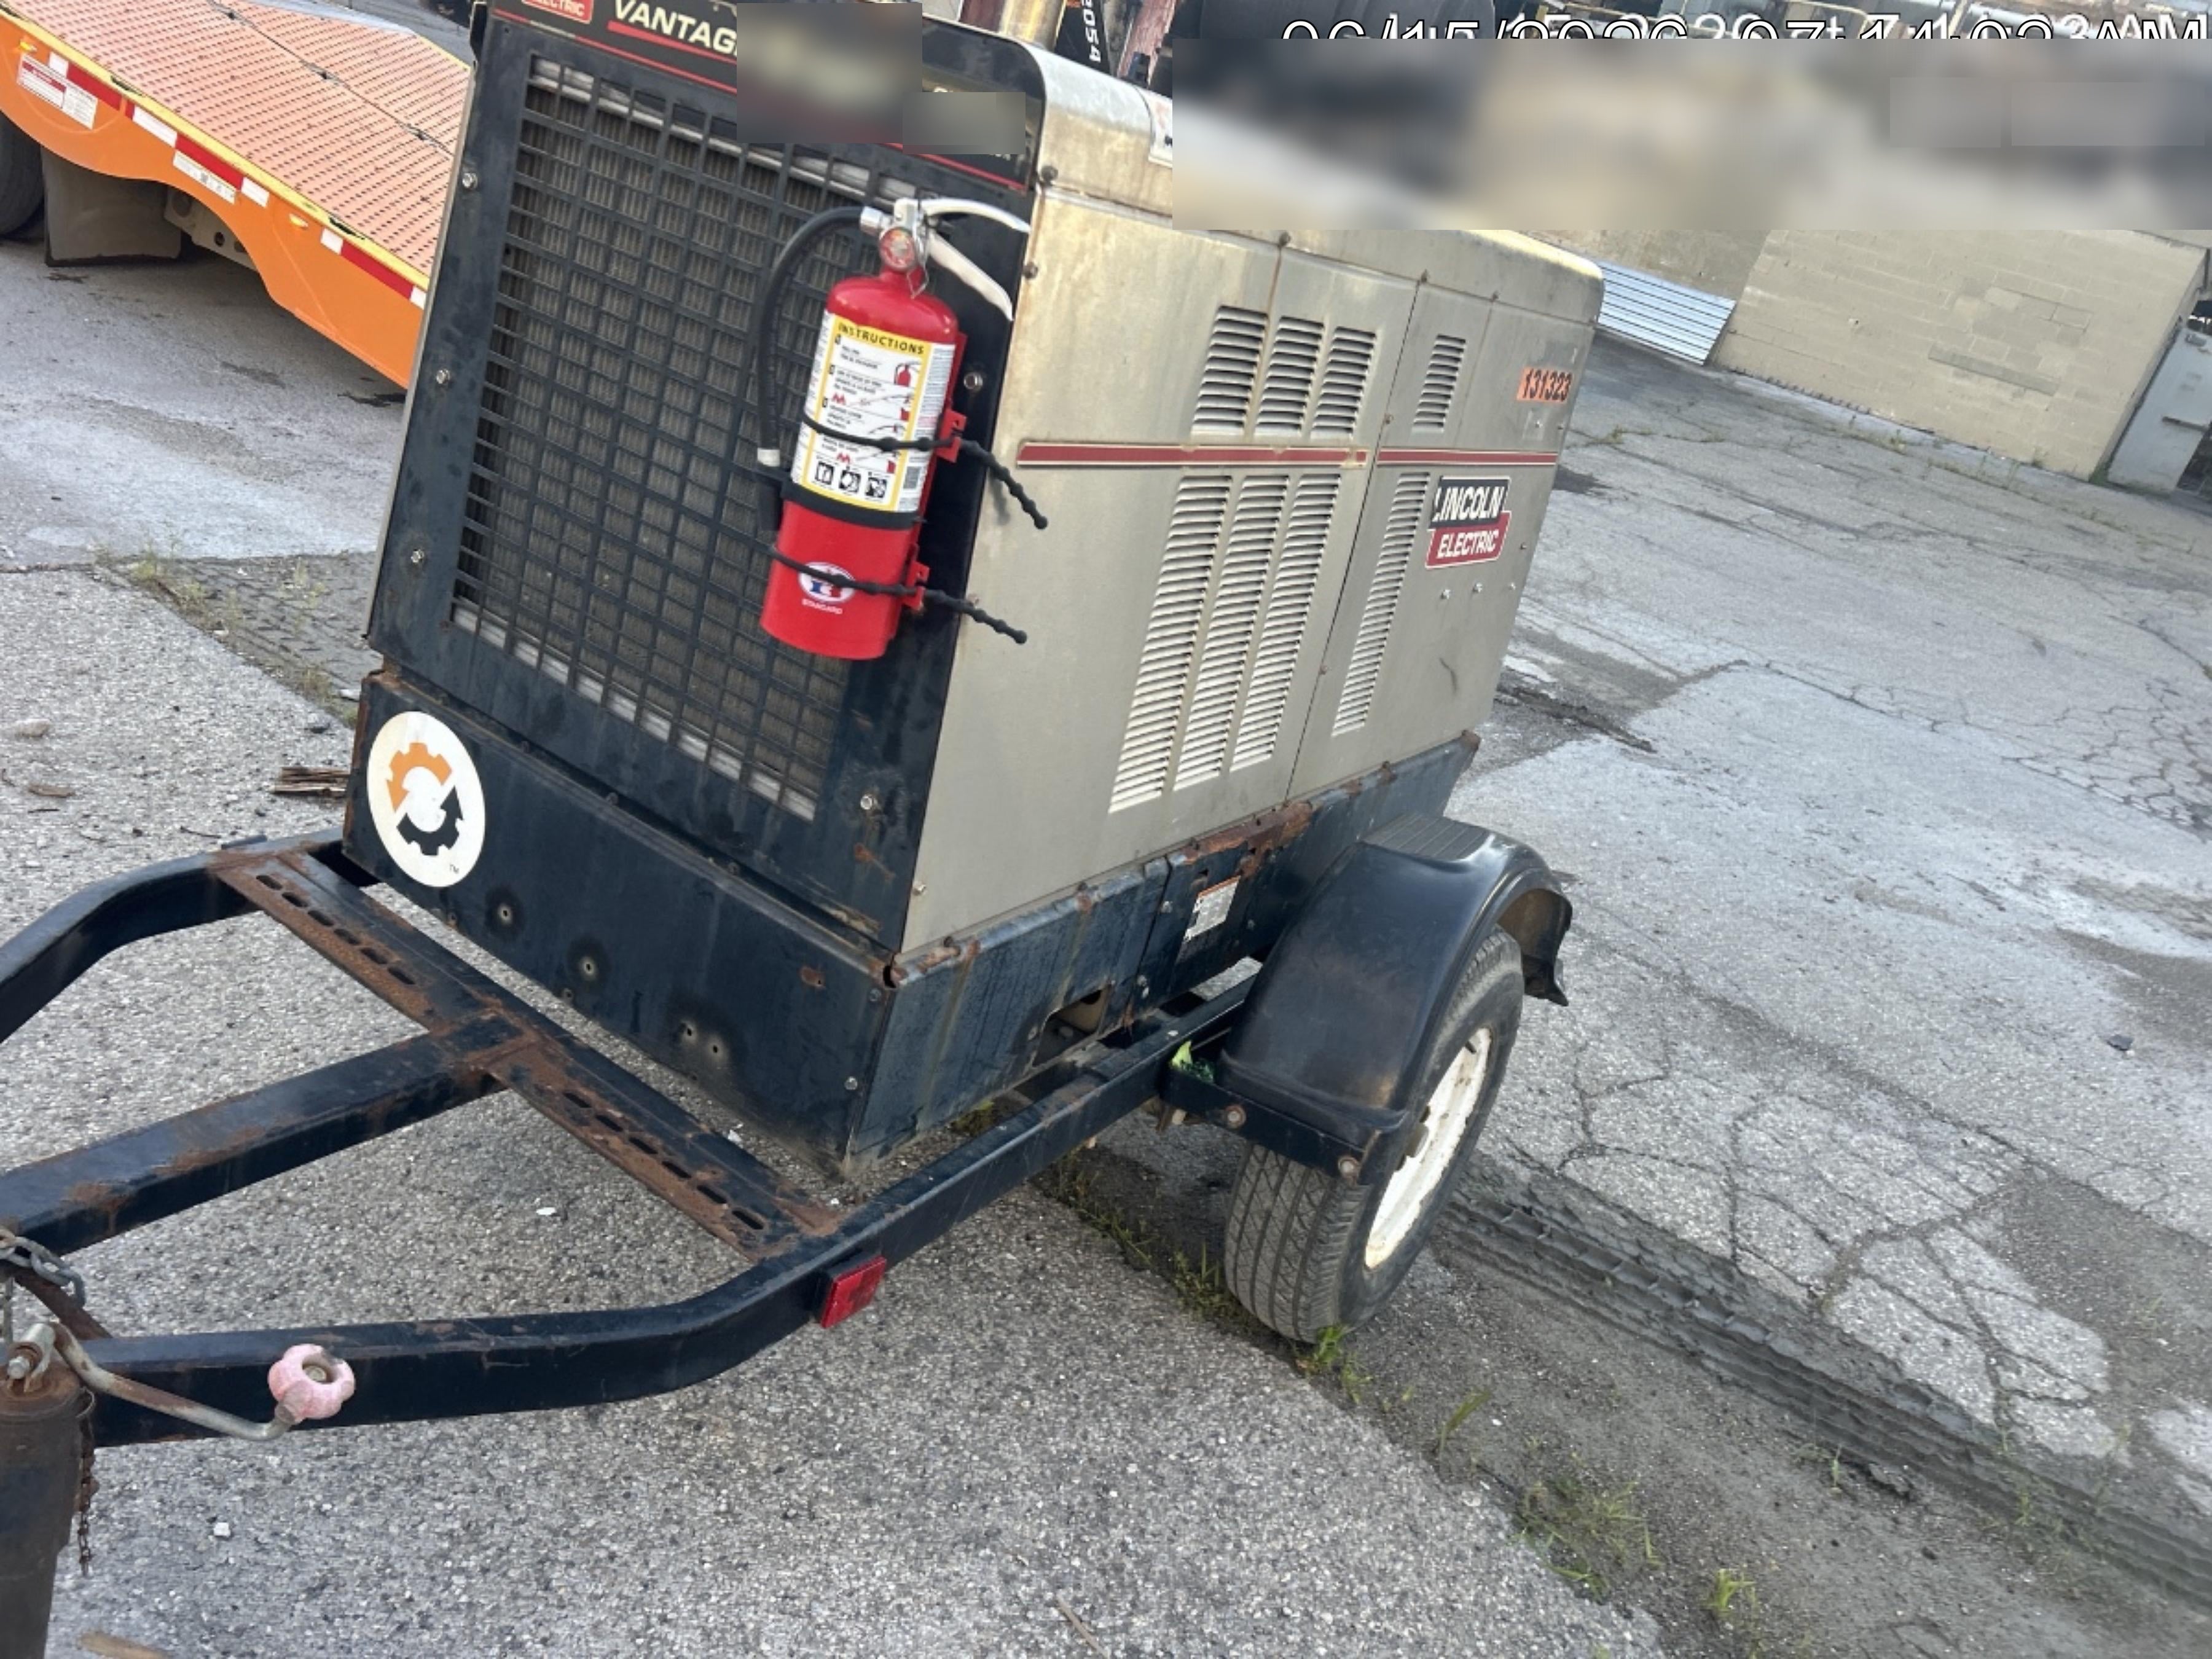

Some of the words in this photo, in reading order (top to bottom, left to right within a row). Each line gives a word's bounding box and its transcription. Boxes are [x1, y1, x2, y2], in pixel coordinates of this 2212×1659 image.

[614, 0, 737, 56] VANTAG
[838, 323, 924, 355] INSTRUCTIONS
[1523, 368, 1572, 401] 131323
[1432, 486, 1505, 522] LINCOLN
[1436, 529, 1499, 559] ELECTRIC
